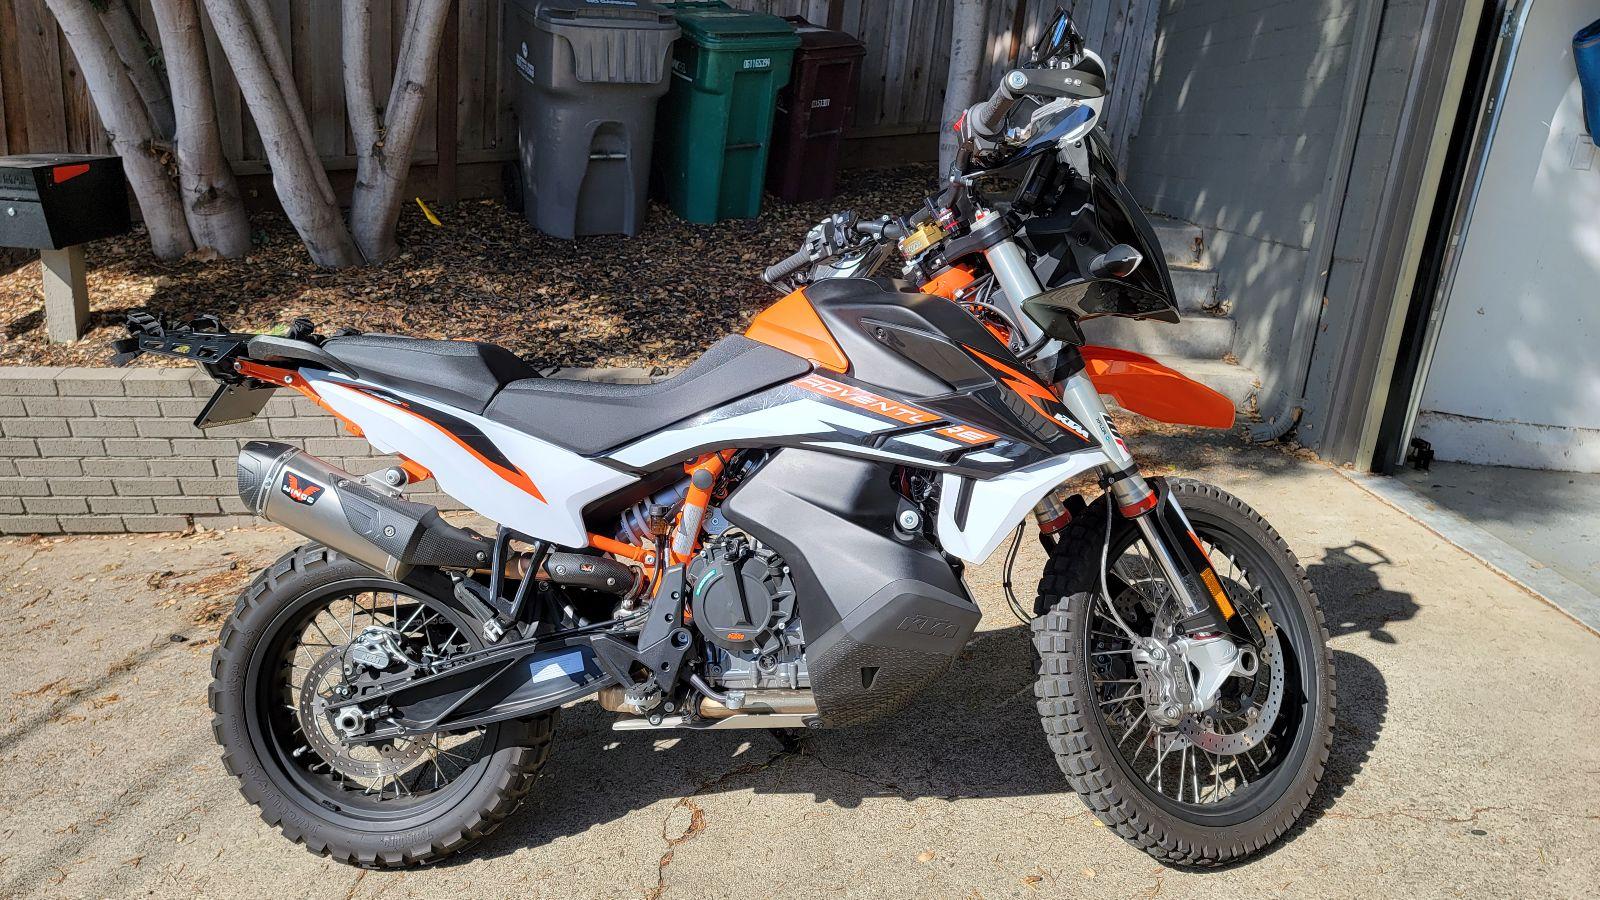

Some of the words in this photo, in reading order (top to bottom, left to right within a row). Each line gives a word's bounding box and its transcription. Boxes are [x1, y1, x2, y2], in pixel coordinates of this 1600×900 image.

[1054, 413, 1088, 438] KTM
[283, 485, 314, 503] WINGS
[727, 632, 745, 640] KTM
[896, 614, 960, 639] KTM
